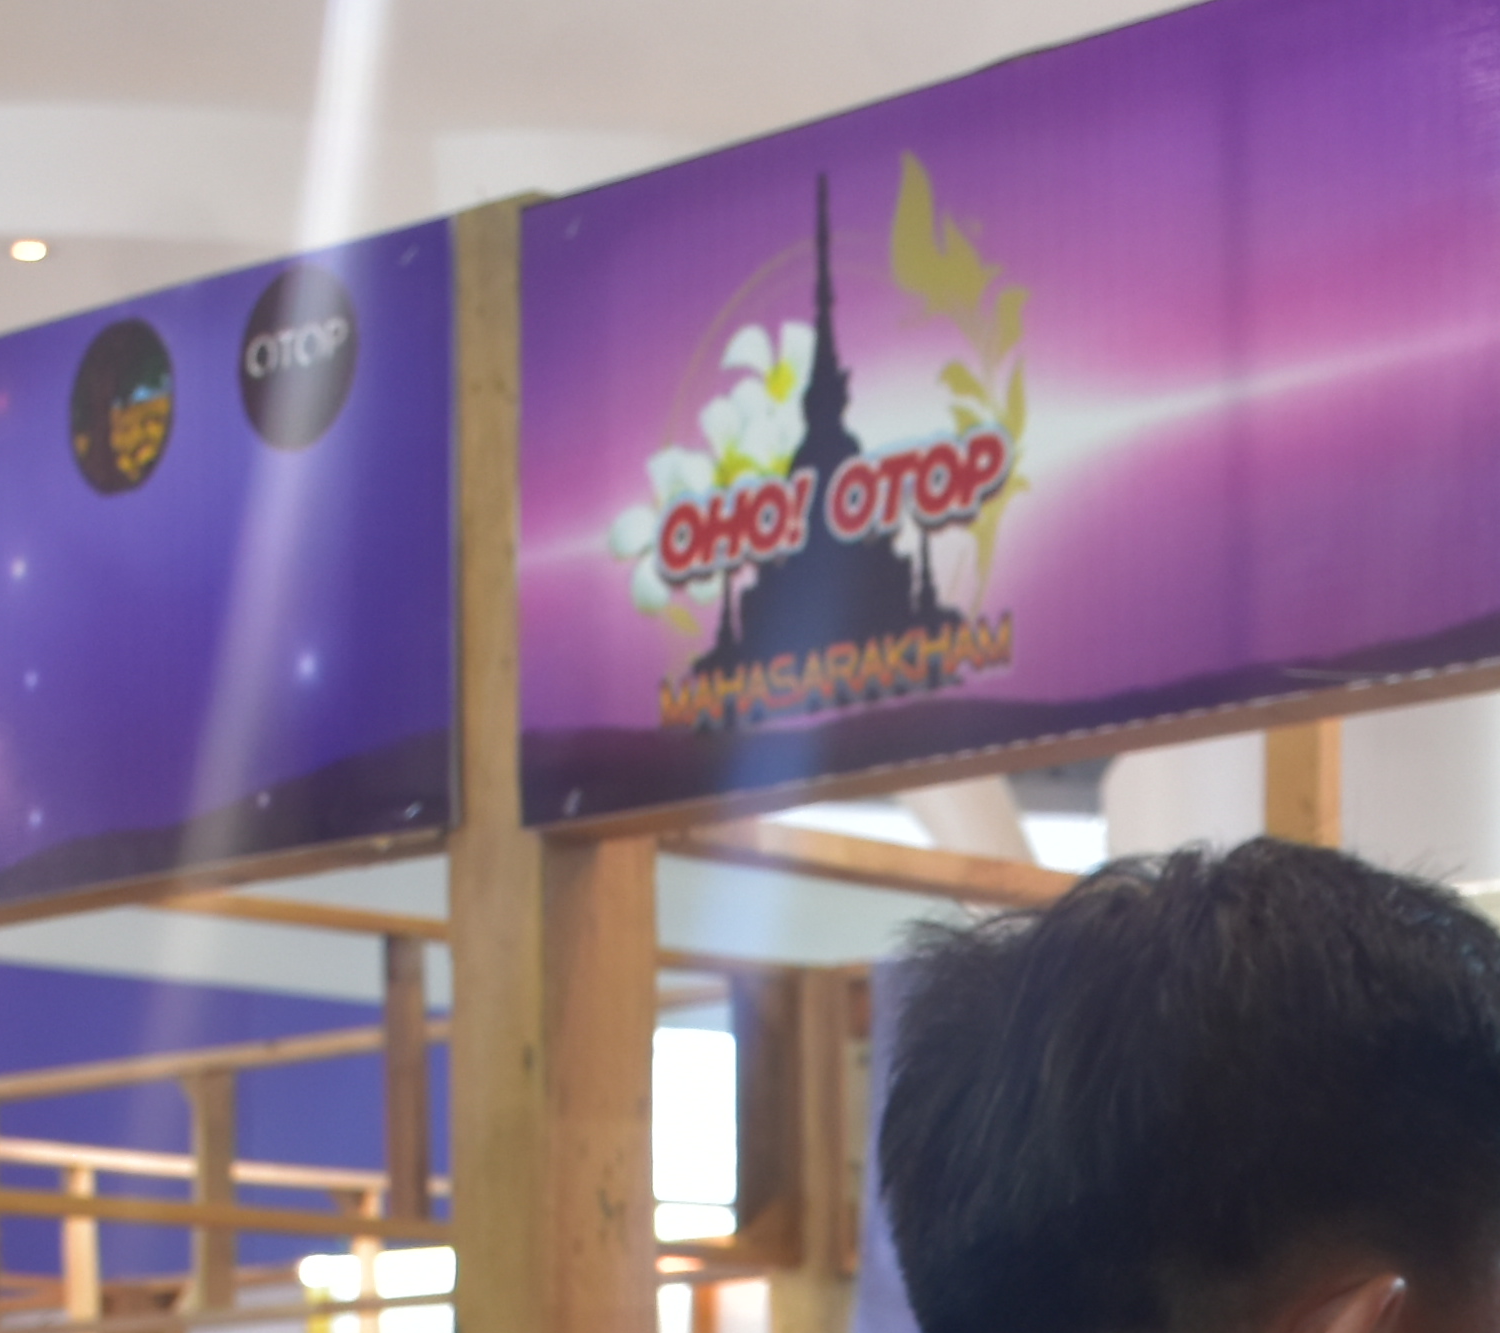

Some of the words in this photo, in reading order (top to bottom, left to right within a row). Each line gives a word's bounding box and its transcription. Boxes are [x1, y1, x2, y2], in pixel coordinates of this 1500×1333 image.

[658, 469, 817, 582] OHO!
[826, 430, 1010, 540] OTOP
[658, 613, 1013, 728] MAHASARAKHAM
